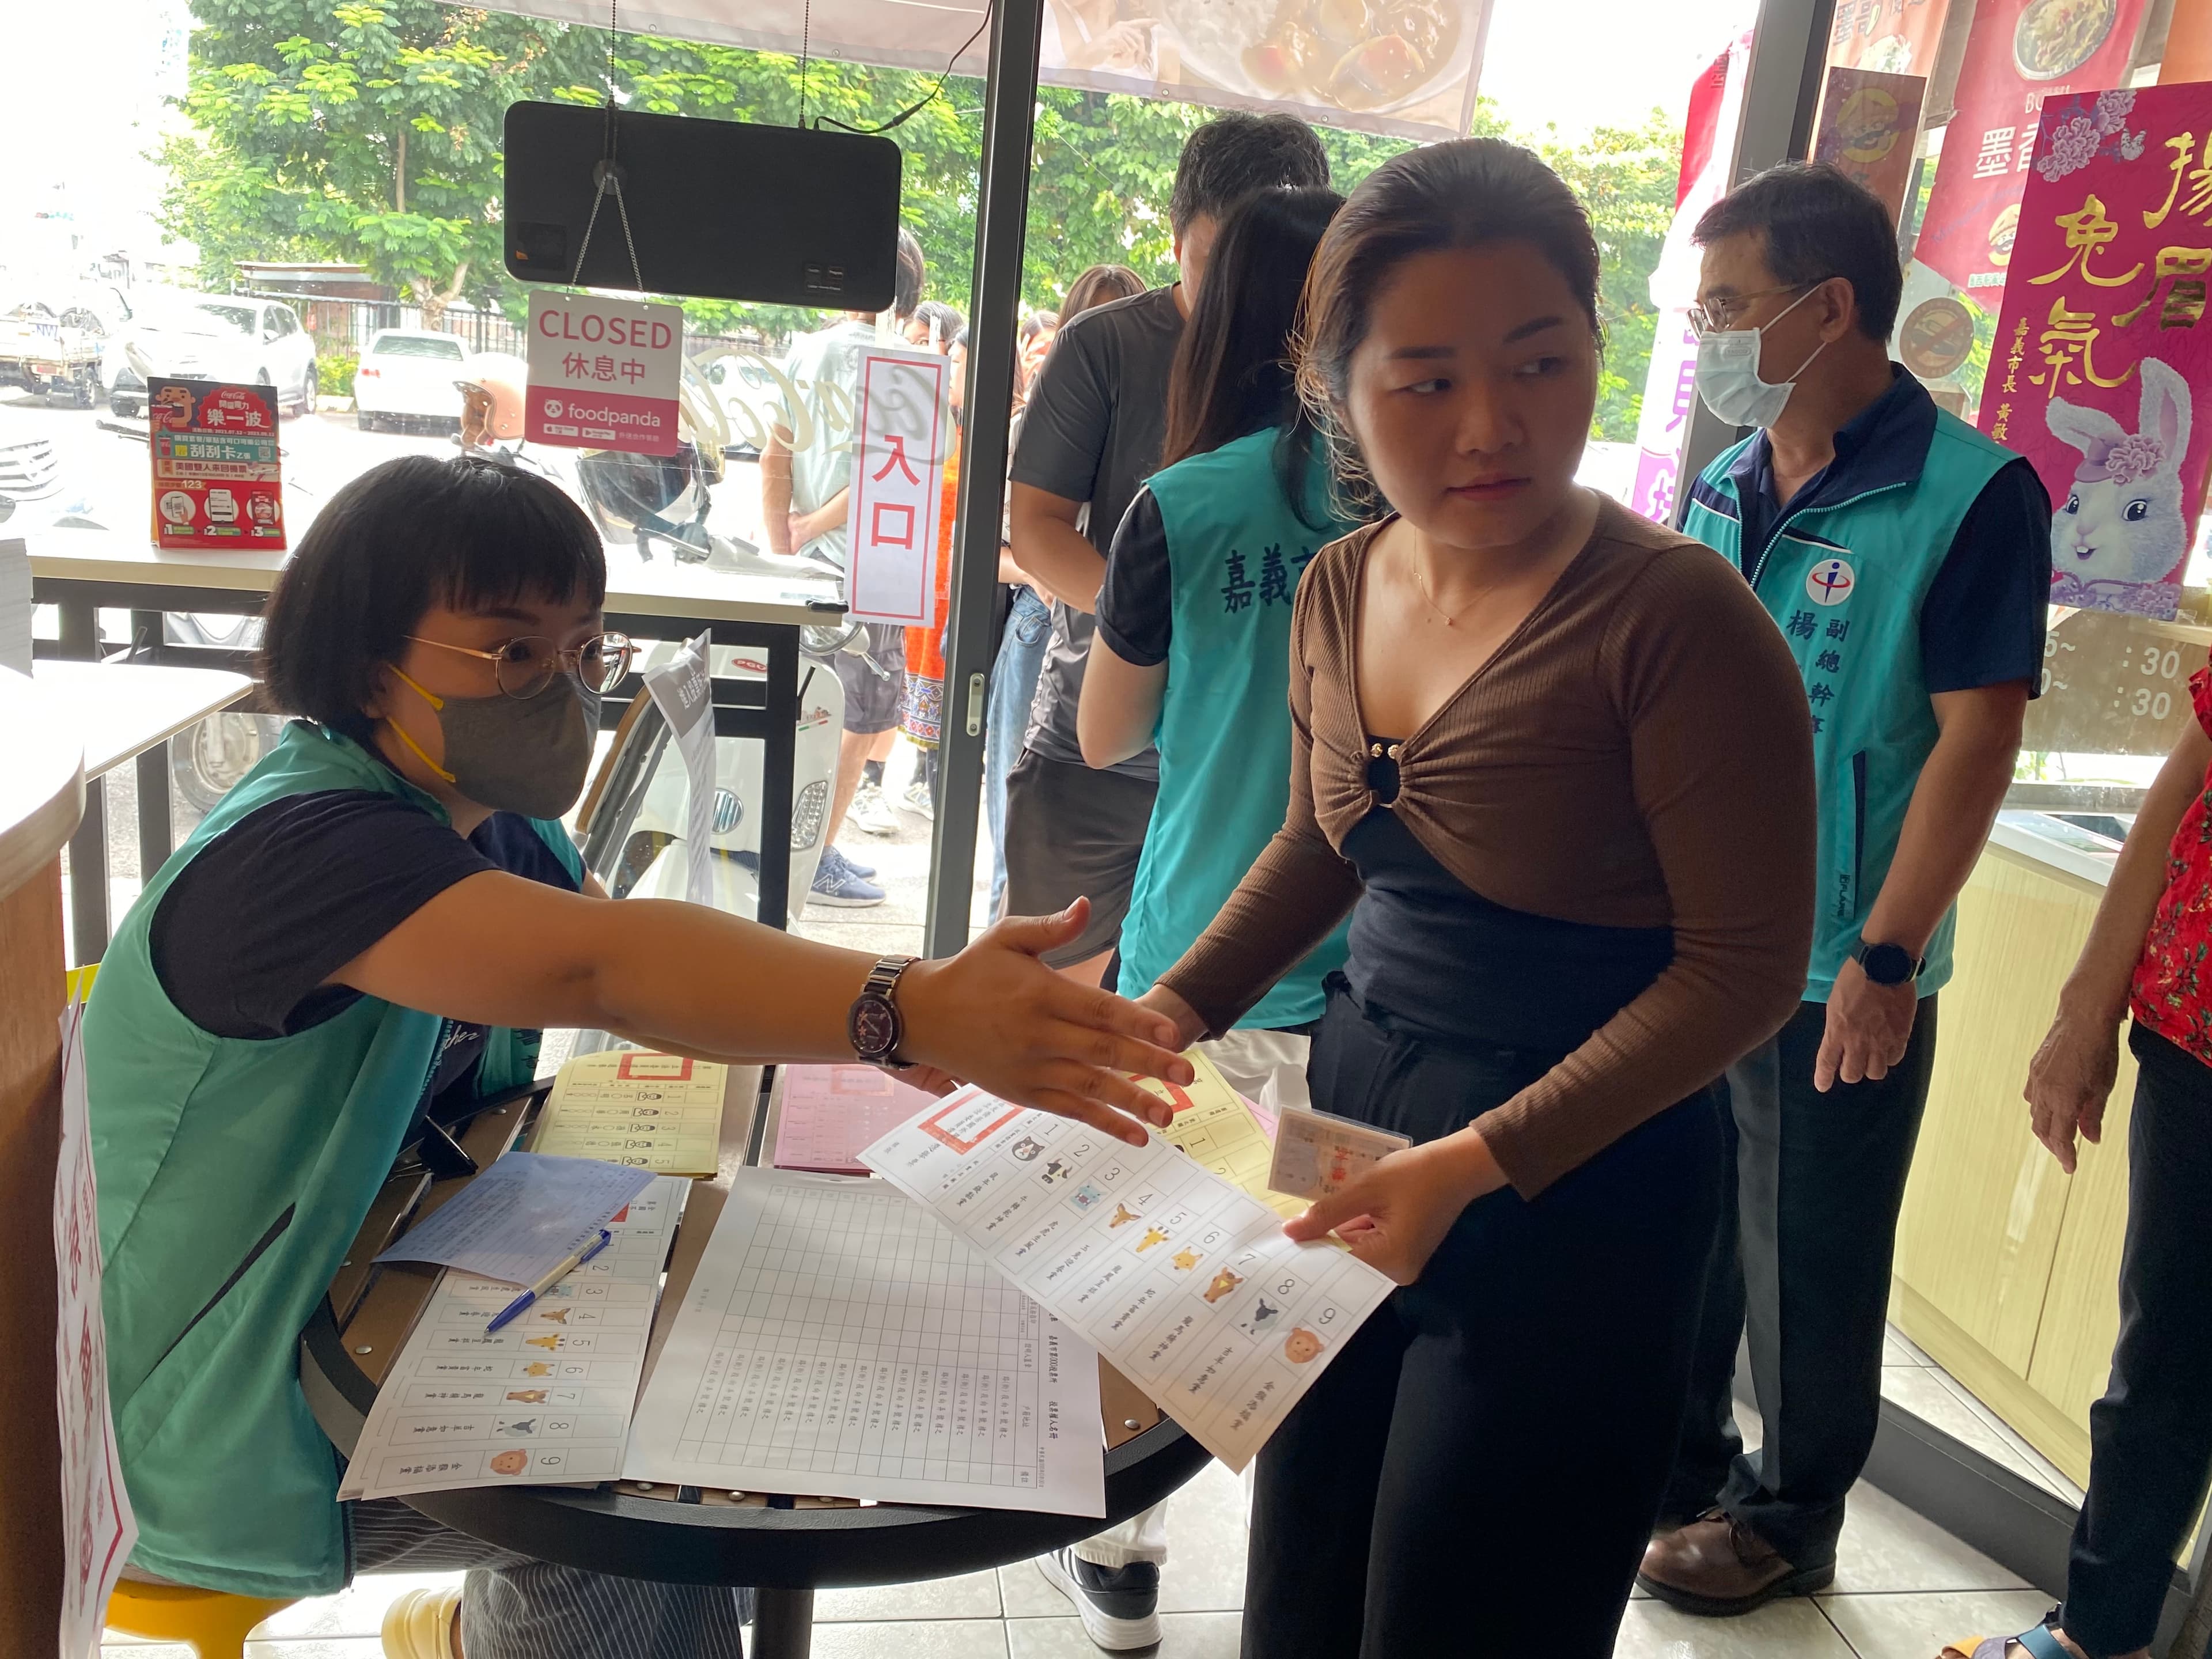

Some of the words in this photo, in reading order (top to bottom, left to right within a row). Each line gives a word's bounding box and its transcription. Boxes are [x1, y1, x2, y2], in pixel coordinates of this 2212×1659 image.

[539, 310, 671, 349] CLOSED
[2002, 317, 2030, 393] 嘉義市長
[562, 351, 645, 385] 休息中
[207, 408, 270, 428] 樂一波
[569, 404, 660, 427] foodpanda
[1991, 403, 2013, 444] 黃敏
[190, 444, 236, 459] 刮刮卡
[181, 480, 202, 489] 123
[870, 434, 922, 550] 入口
[1045, 1124, 1058, 1137] 1
[1190, 1136, 1205, 1149] 1
[1077, 1143, 1090, 1157] 2
[1105, 1166, 1120, 1180] 3
[1137, 1192, 1152, 1205] 4
[1170, 1211, 1185, 1225] 5
[1203, 1230, 1217, 1244] 6
[1243, 1253, 1257, 1266] 7
[591, 1264, 609, 1273] 2
[585, 1287, 604, 1296] 3
[1278, 1279, 1295, 1295] 8
[578, 1312, 597, 1322] 4
[1319, 1308, 1337, 1325] 9
[572, 1338, 591, 1348] 5
[565, 1366, 584, 1375] 6
[556, 1392, 576, 1402] 7
[549, 1421, 570, 1431] 8
[540, 1455, 561, 1467] 9
